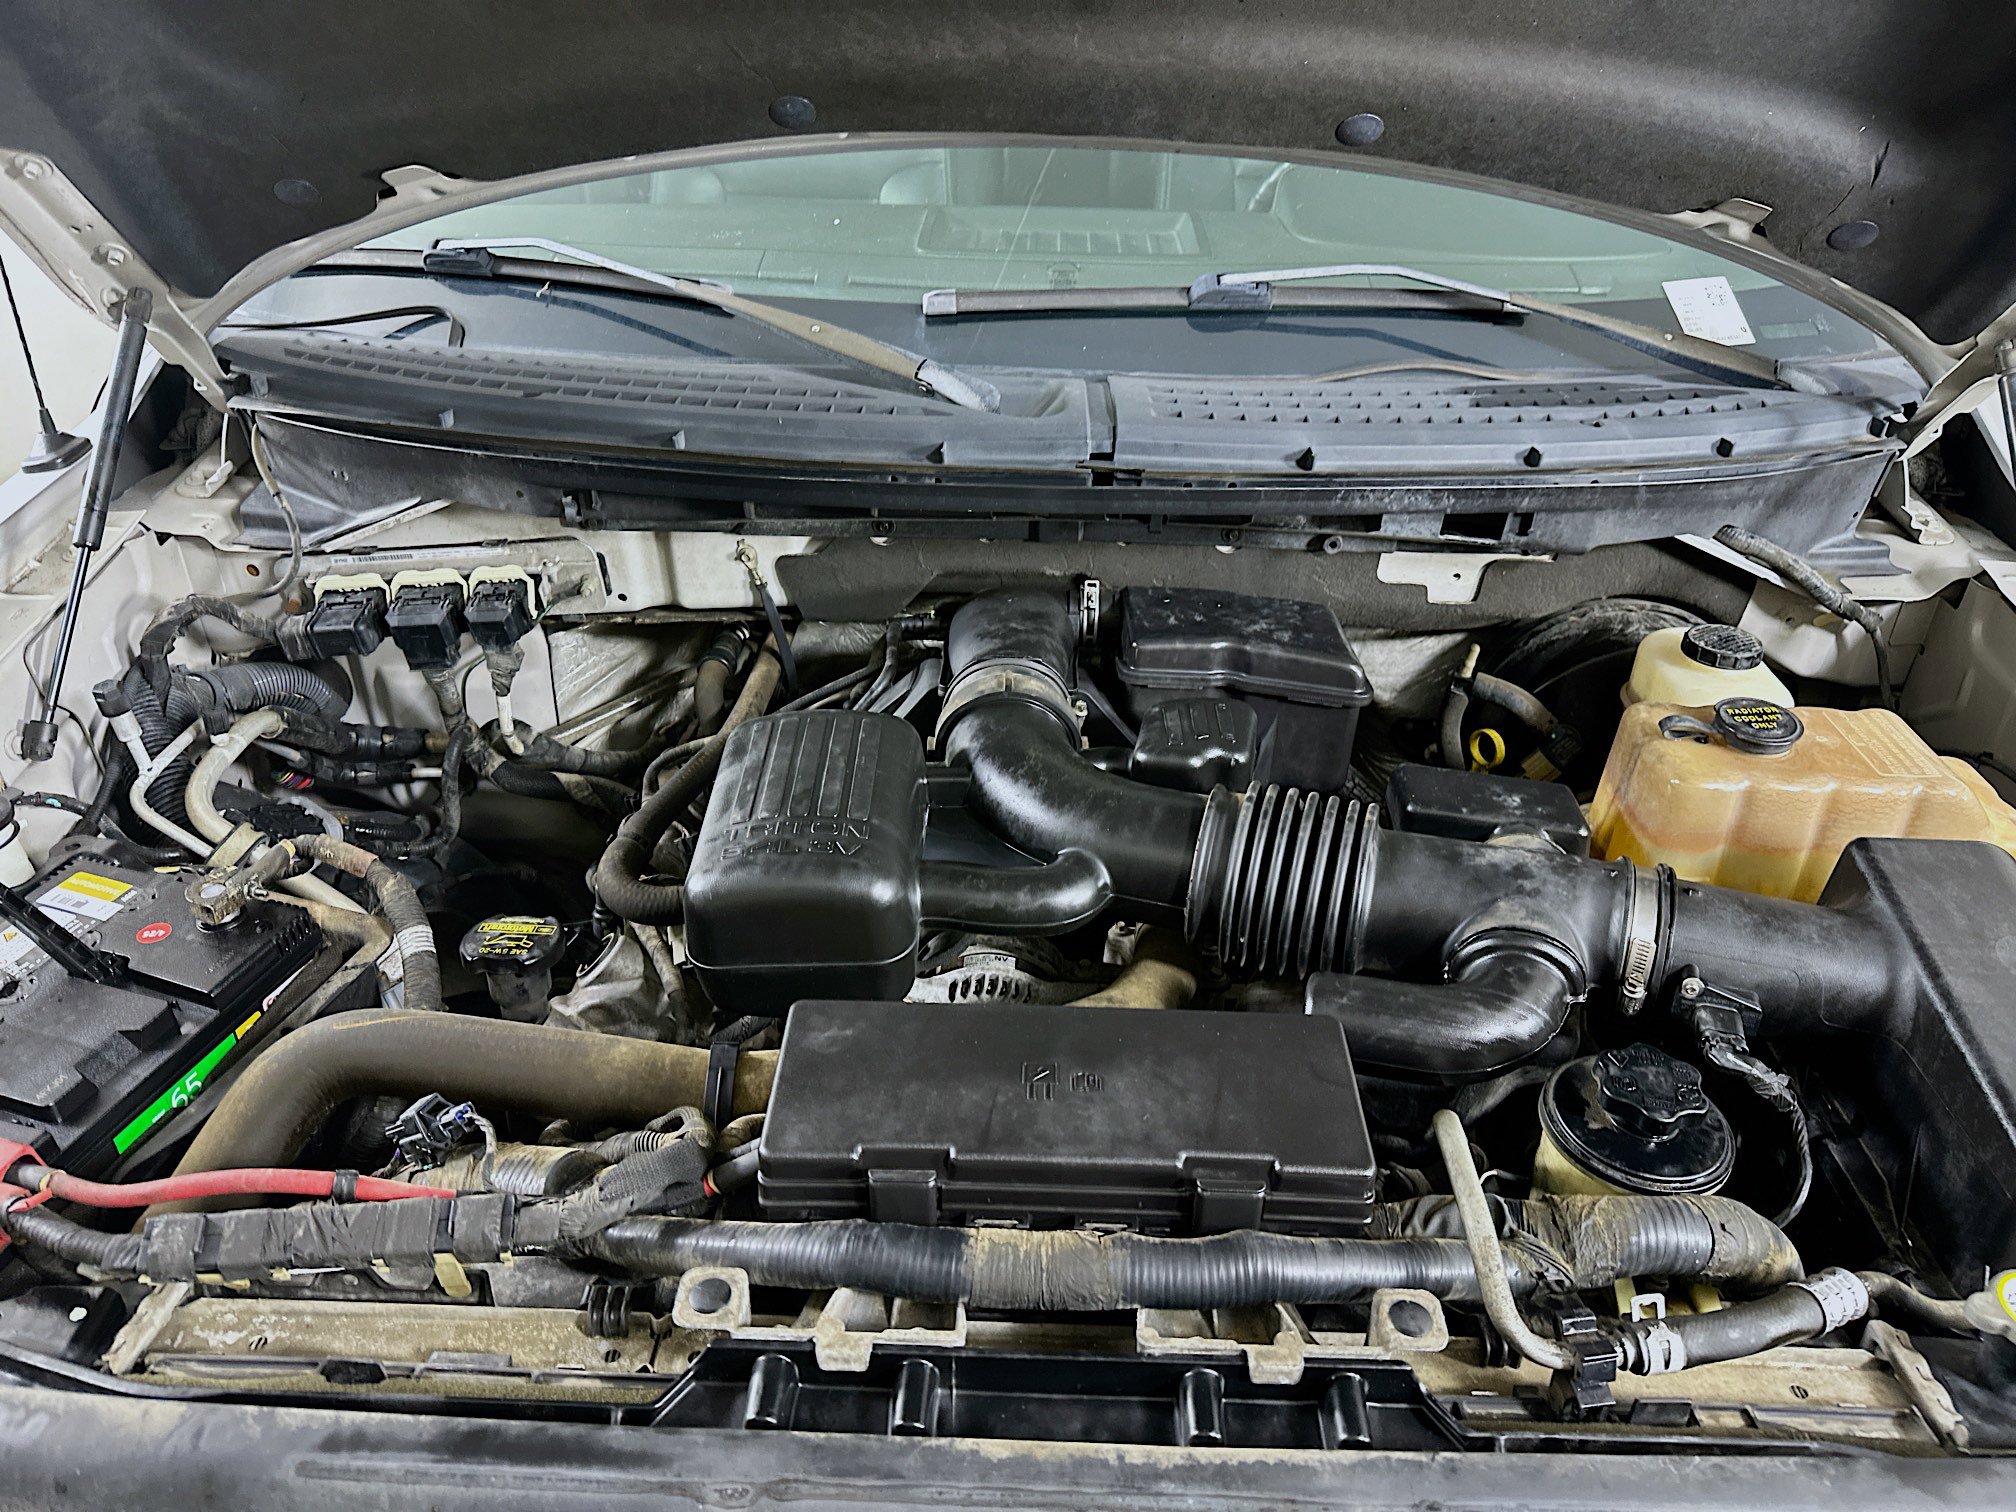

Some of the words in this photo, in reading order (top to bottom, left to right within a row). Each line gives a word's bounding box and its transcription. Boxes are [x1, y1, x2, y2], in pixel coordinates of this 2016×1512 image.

[1726, 706, 1779, 715] RADIATOR
[1734, 714, 1783, 722] COOLANT
[1751, 721, 1778, 729] ONLY
[724, 820, 870, 842] TRITON
